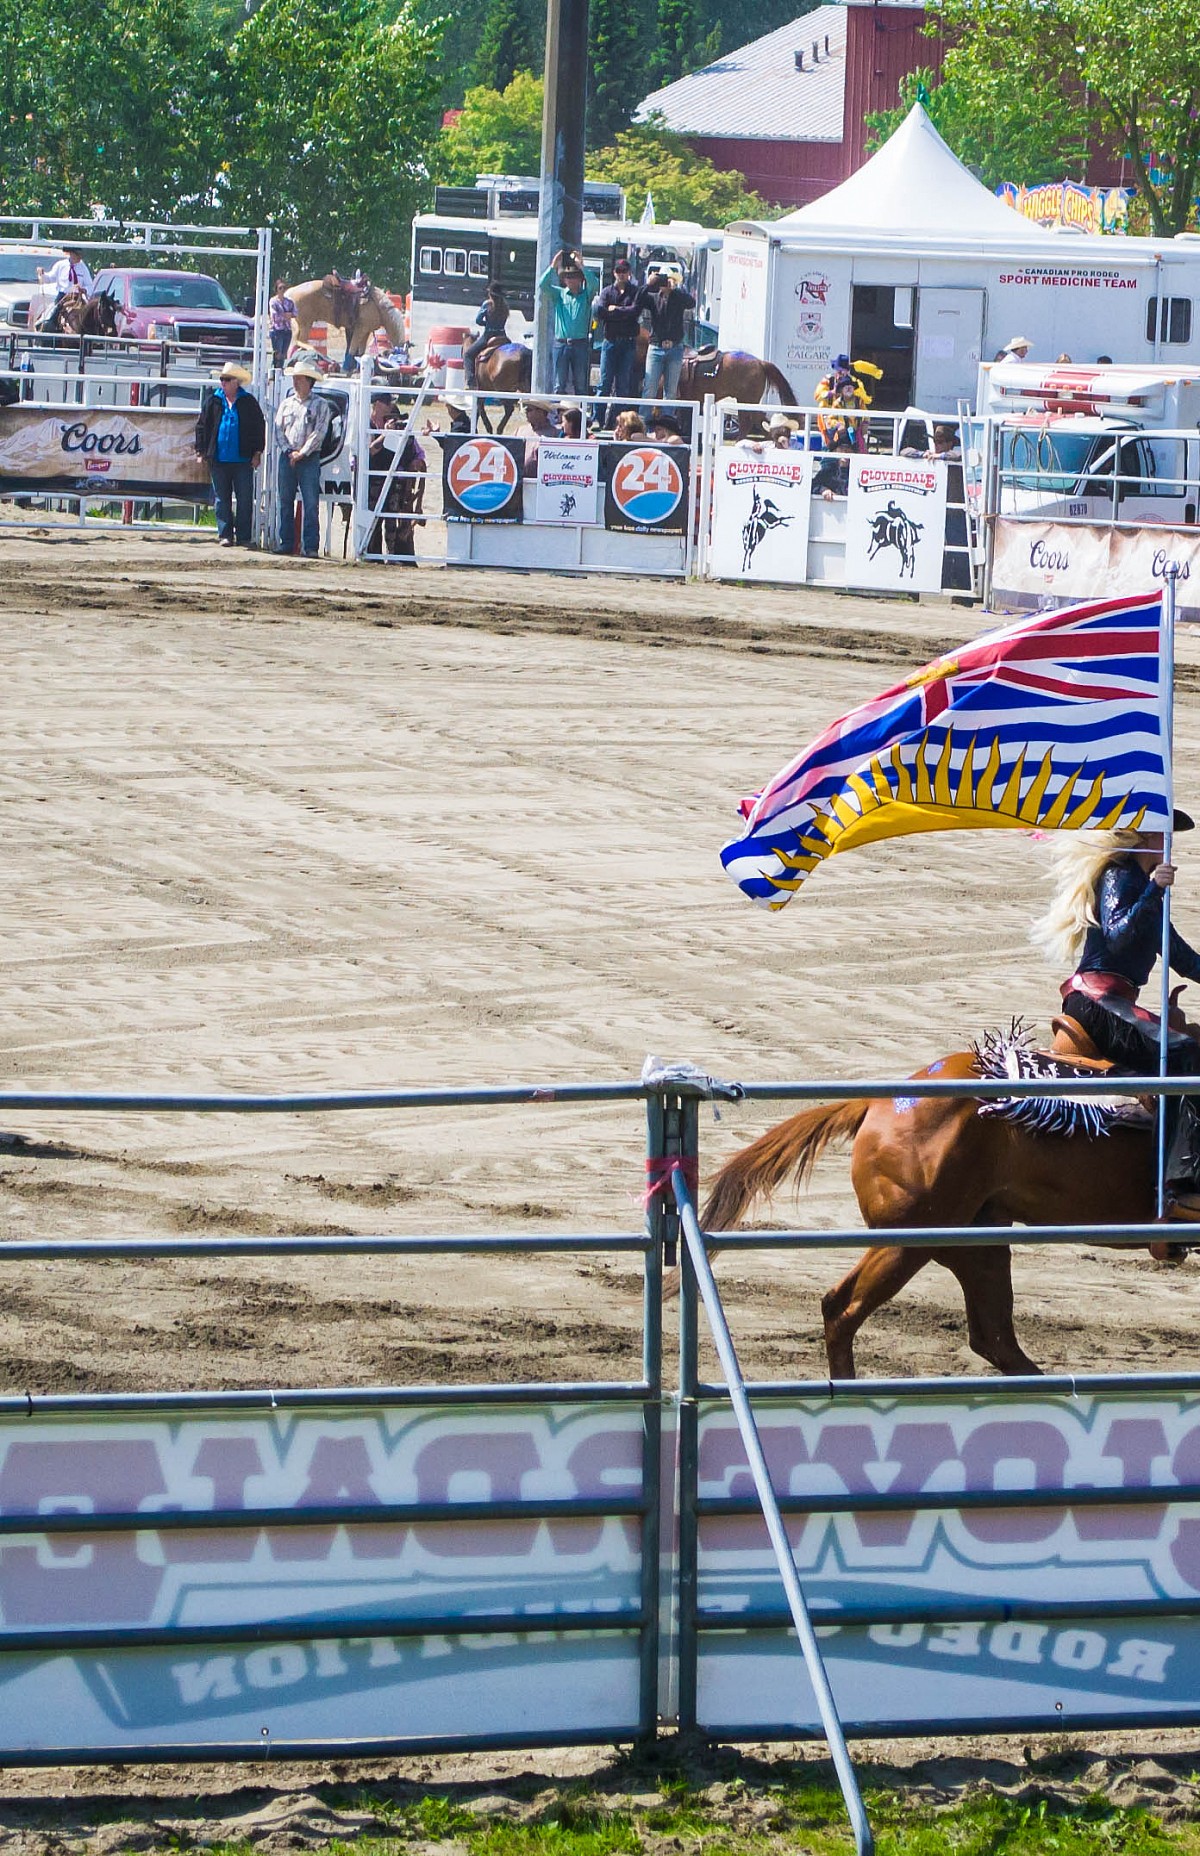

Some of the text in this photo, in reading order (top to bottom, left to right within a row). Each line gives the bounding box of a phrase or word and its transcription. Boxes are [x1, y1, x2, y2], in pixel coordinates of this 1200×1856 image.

[1023, 186, 1094, 232] WIGGLE CHIPS
[999, 275, 1137, 289] SPORT MEDICINE TEAM
[1025, 268, 1070, 276] CANADIAN
[1090, 270, 1120, 278] RODEO
[787, 351, 830, 360] CALGARY
[60, 422, 143, 455] Coors
[456, 445, 506, 482] 24
[543, 450, 593, 461] Welcome to
[561, 461, 575, 470] the
[621, 455, 671, 491] 24
[728, 462, 801, 481] CLOVERDALE
[542, 473, 593, 484] CLOVERDALE
[860, 469, 935, 489] CLOVERDALE
[1029, 540, 1070, 571] Coors
